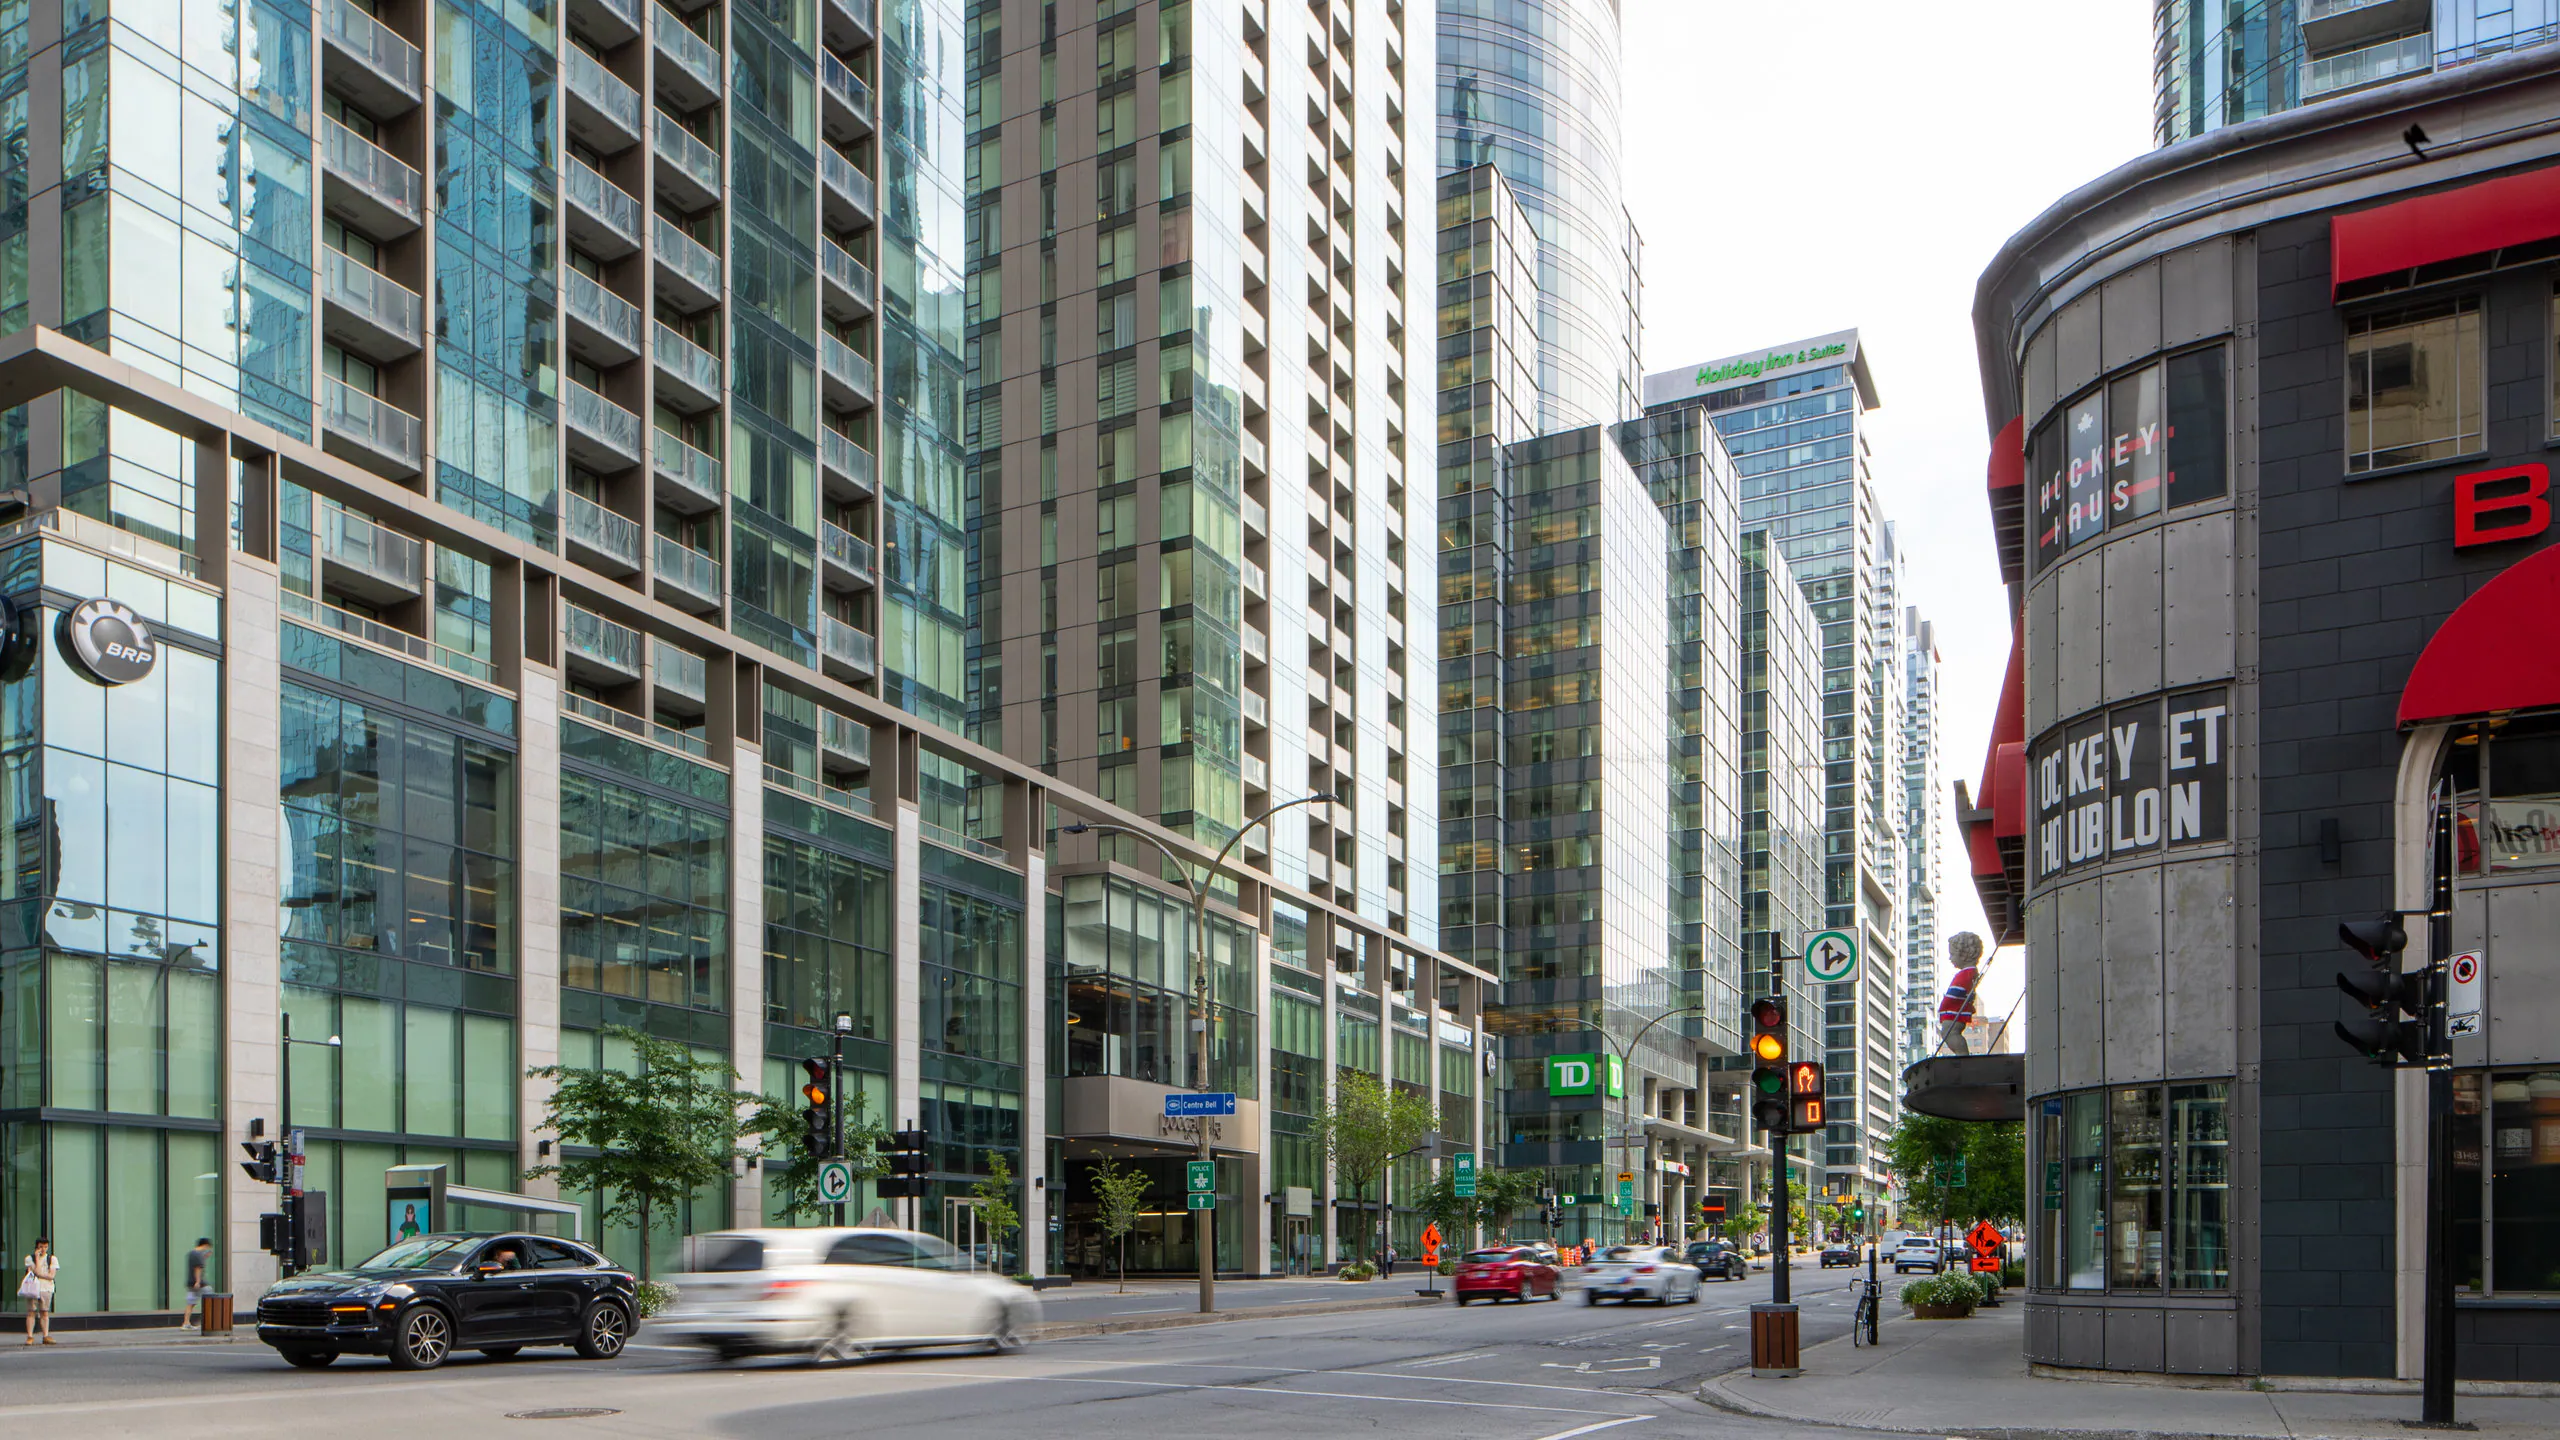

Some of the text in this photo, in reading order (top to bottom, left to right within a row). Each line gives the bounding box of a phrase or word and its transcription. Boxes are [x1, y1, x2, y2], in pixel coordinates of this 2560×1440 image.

[1696, 342, 1846, 385] Holiday Inn & Suites
[106, 642, 152, 663] BRP
[2170, 705, 2226, 770] ET
[2041, 780, 2201, 876] HOUBLON
[1553, 1061, 1590, 1088] TD
[1610, 1062, 1622, 1089] TD
[1183, 1100, 1216, 1109] Centre Bell
[1807, 1101, 1820, 1122] 0
[1562, 1195, 1575, 1204] TD
